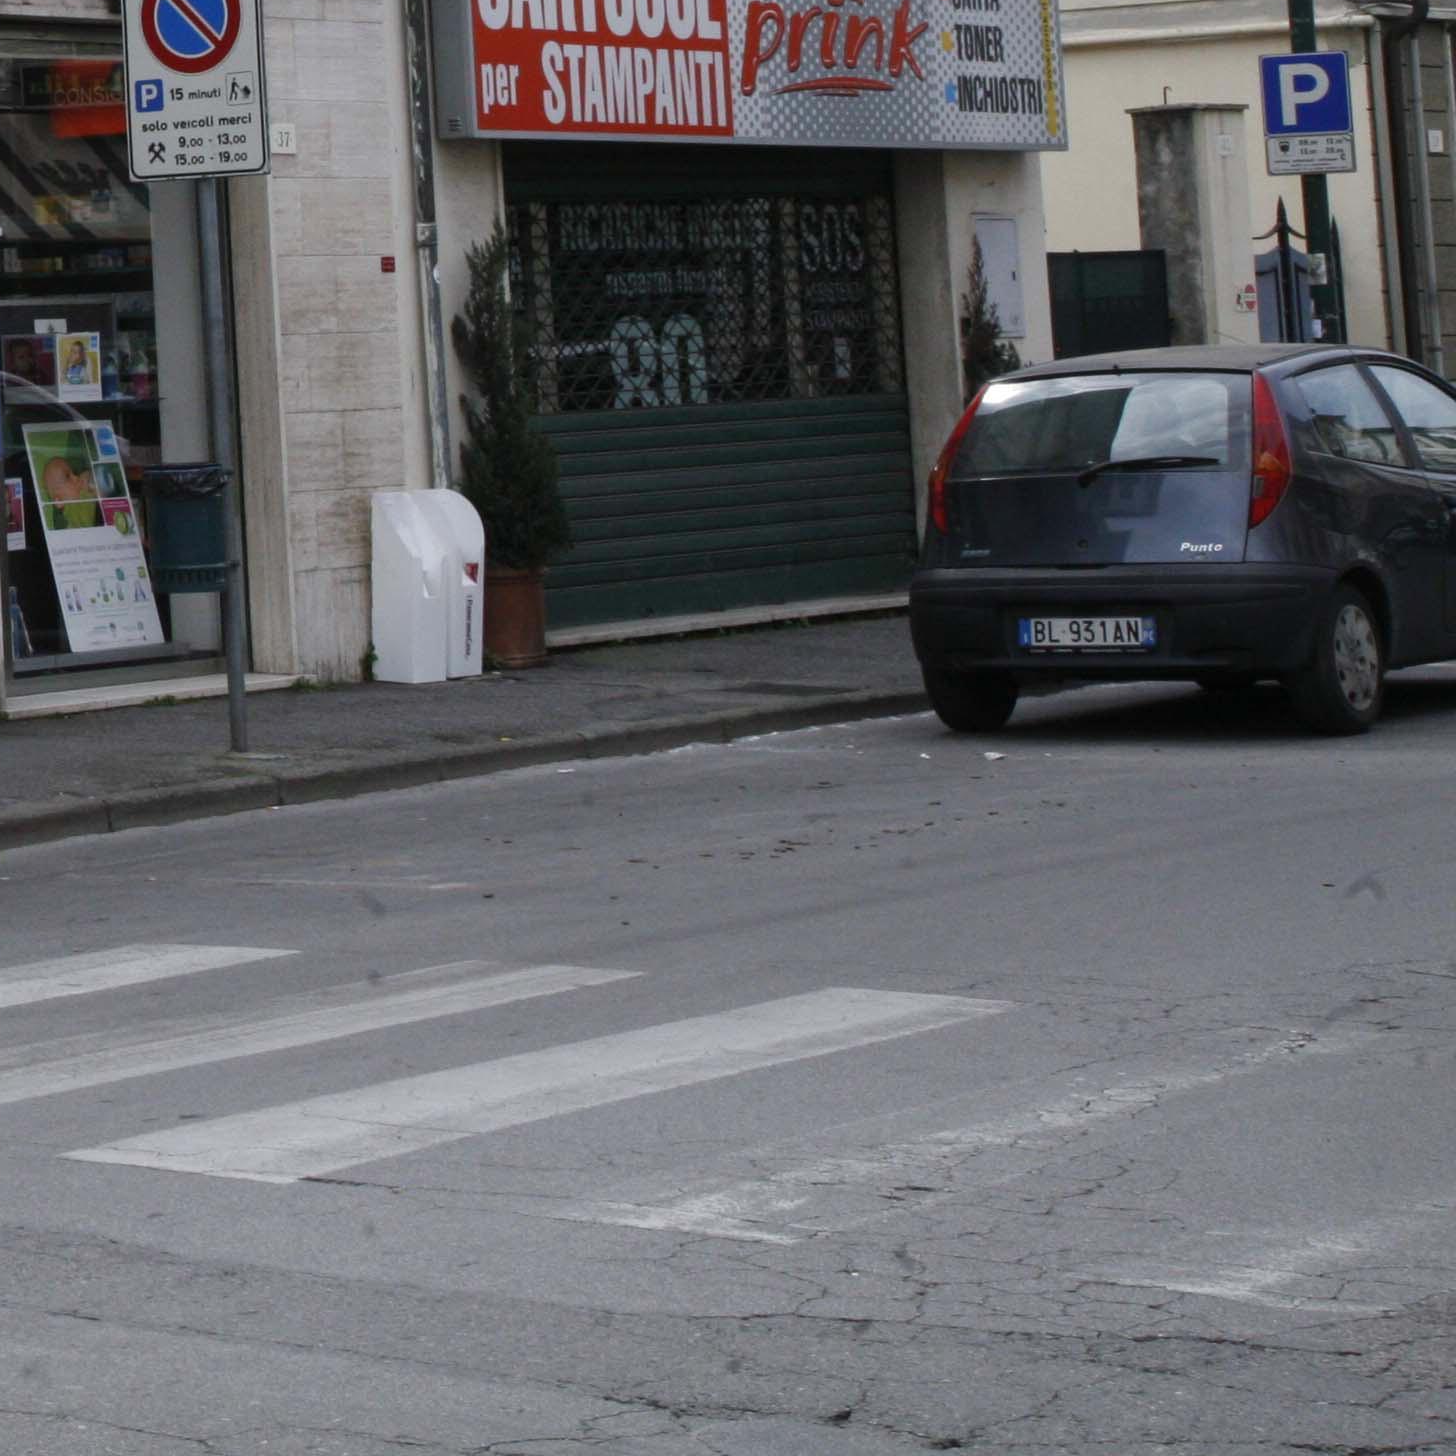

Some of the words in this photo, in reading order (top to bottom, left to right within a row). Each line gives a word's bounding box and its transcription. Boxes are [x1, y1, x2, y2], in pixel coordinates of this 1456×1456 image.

[954, 23, 1005, 63] TONER
[140, 84, 158, 108] P
[169, 87, 184, 101] 15
[188, 87, 221, 100] minuti
[480, 61, 520, 114] per
[541, 40, 728, 128] STAMPANTI
[957, 75, 1043, 114] INCHIOSTRI
[1278, 62, 1330, 126] P
[141, 119, 168, 133] solo
[173, 115, 214, 130] veicoli
[218, 112, 252, 126] merci
[1180, 542, 1224, 552] Punto
[1033, 621, 1061, 643] BL
[1068, 620, 1139, 643] 931AN
